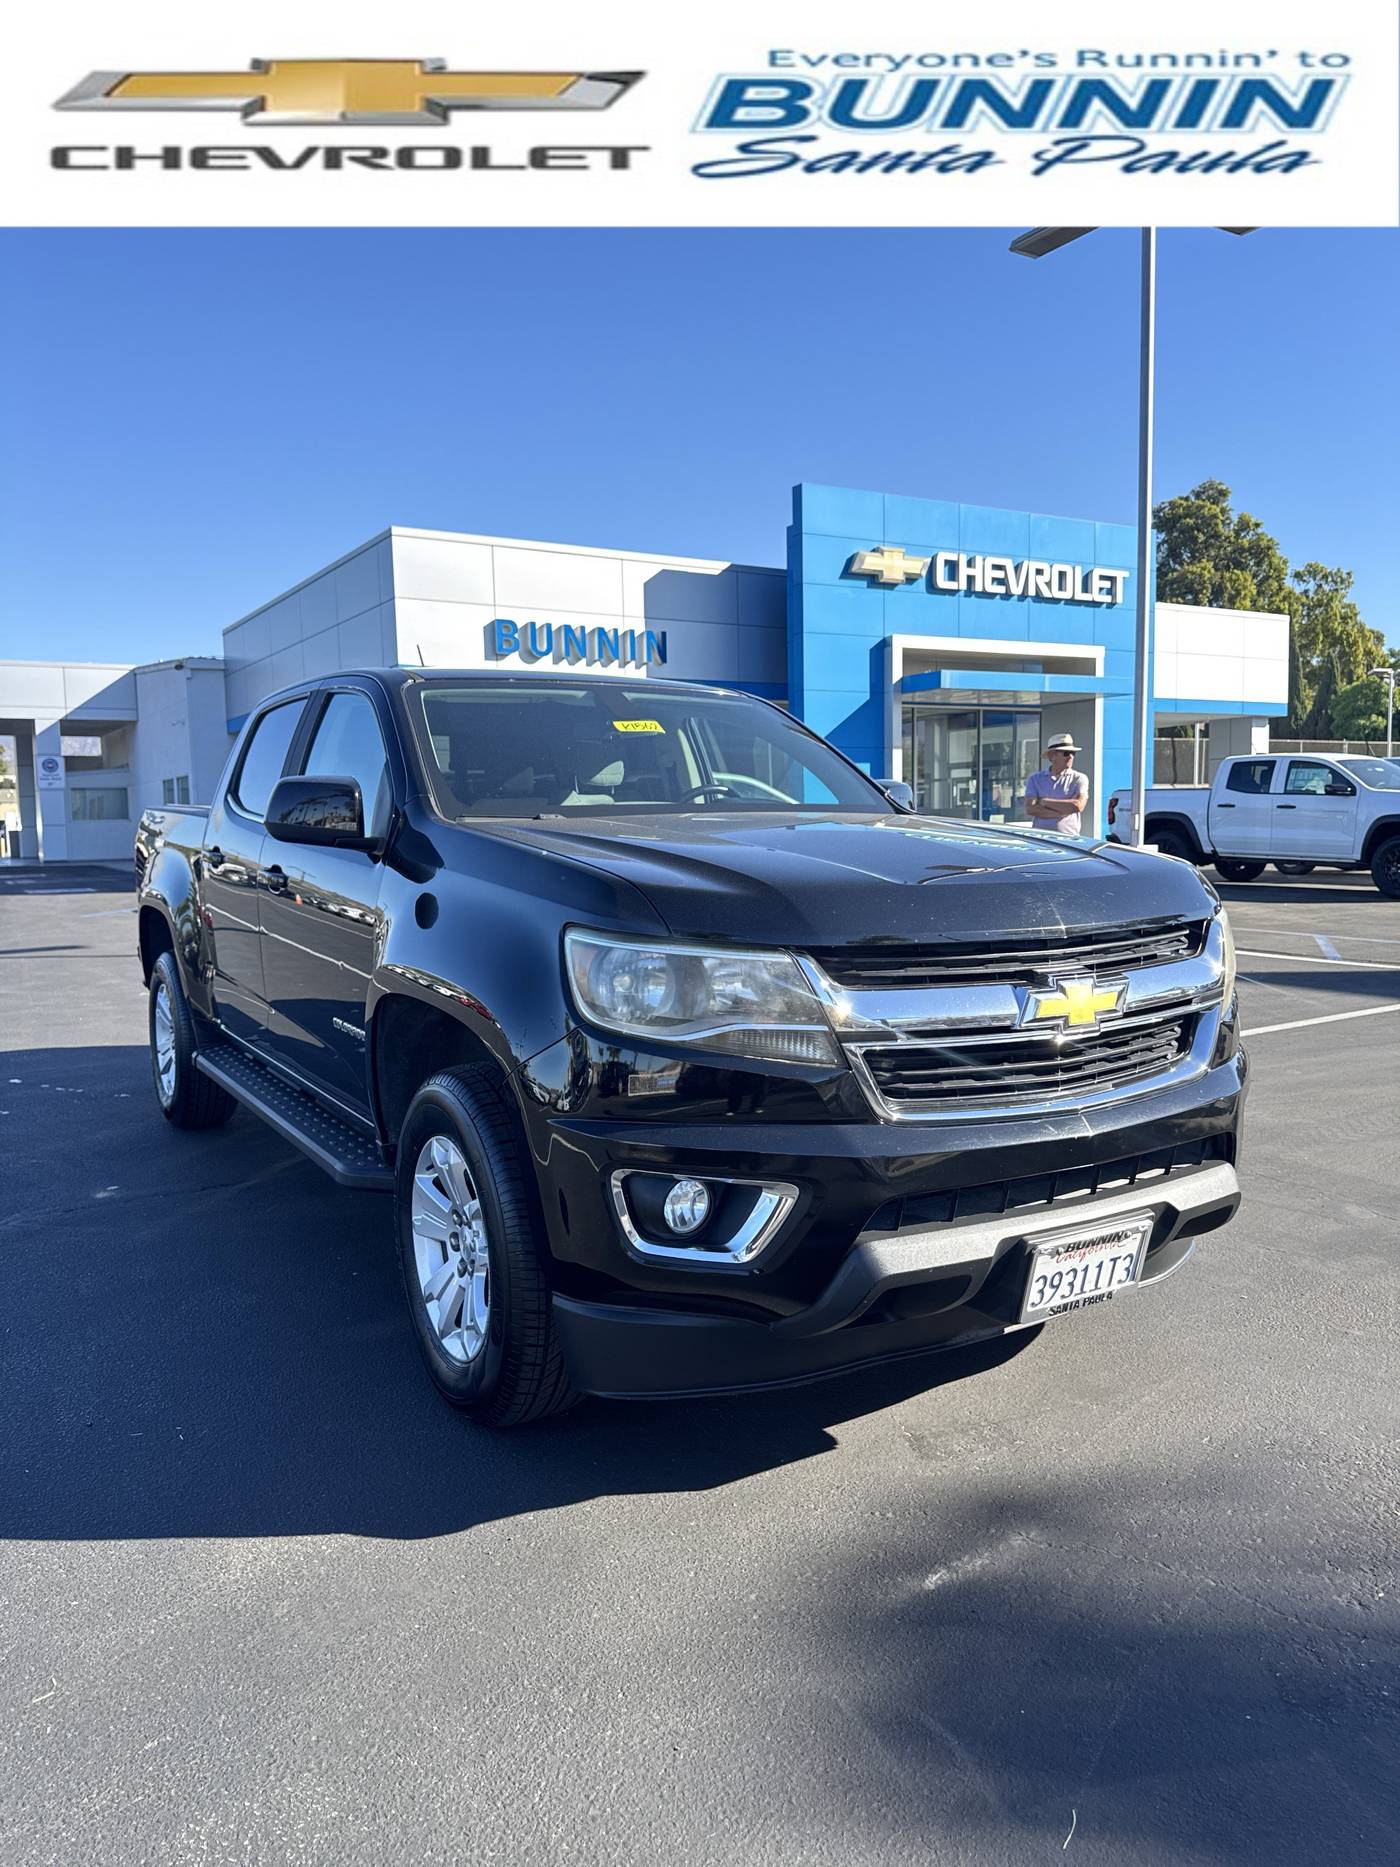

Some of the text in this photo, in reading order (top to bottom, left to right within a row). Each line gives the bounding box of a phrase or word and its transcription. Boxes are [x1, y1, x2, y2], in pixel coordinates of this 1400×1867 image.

[934, 551, 1130, 604] CHEVROLET
[487, 619, 668, 667] BUNNIN
[1063, 1230, 1125, 1254] BUNNIN
[1030, 1252, 1136, 1309] 39311T3
[1048, 1290, 1113, 1317] SANTA PAULA
